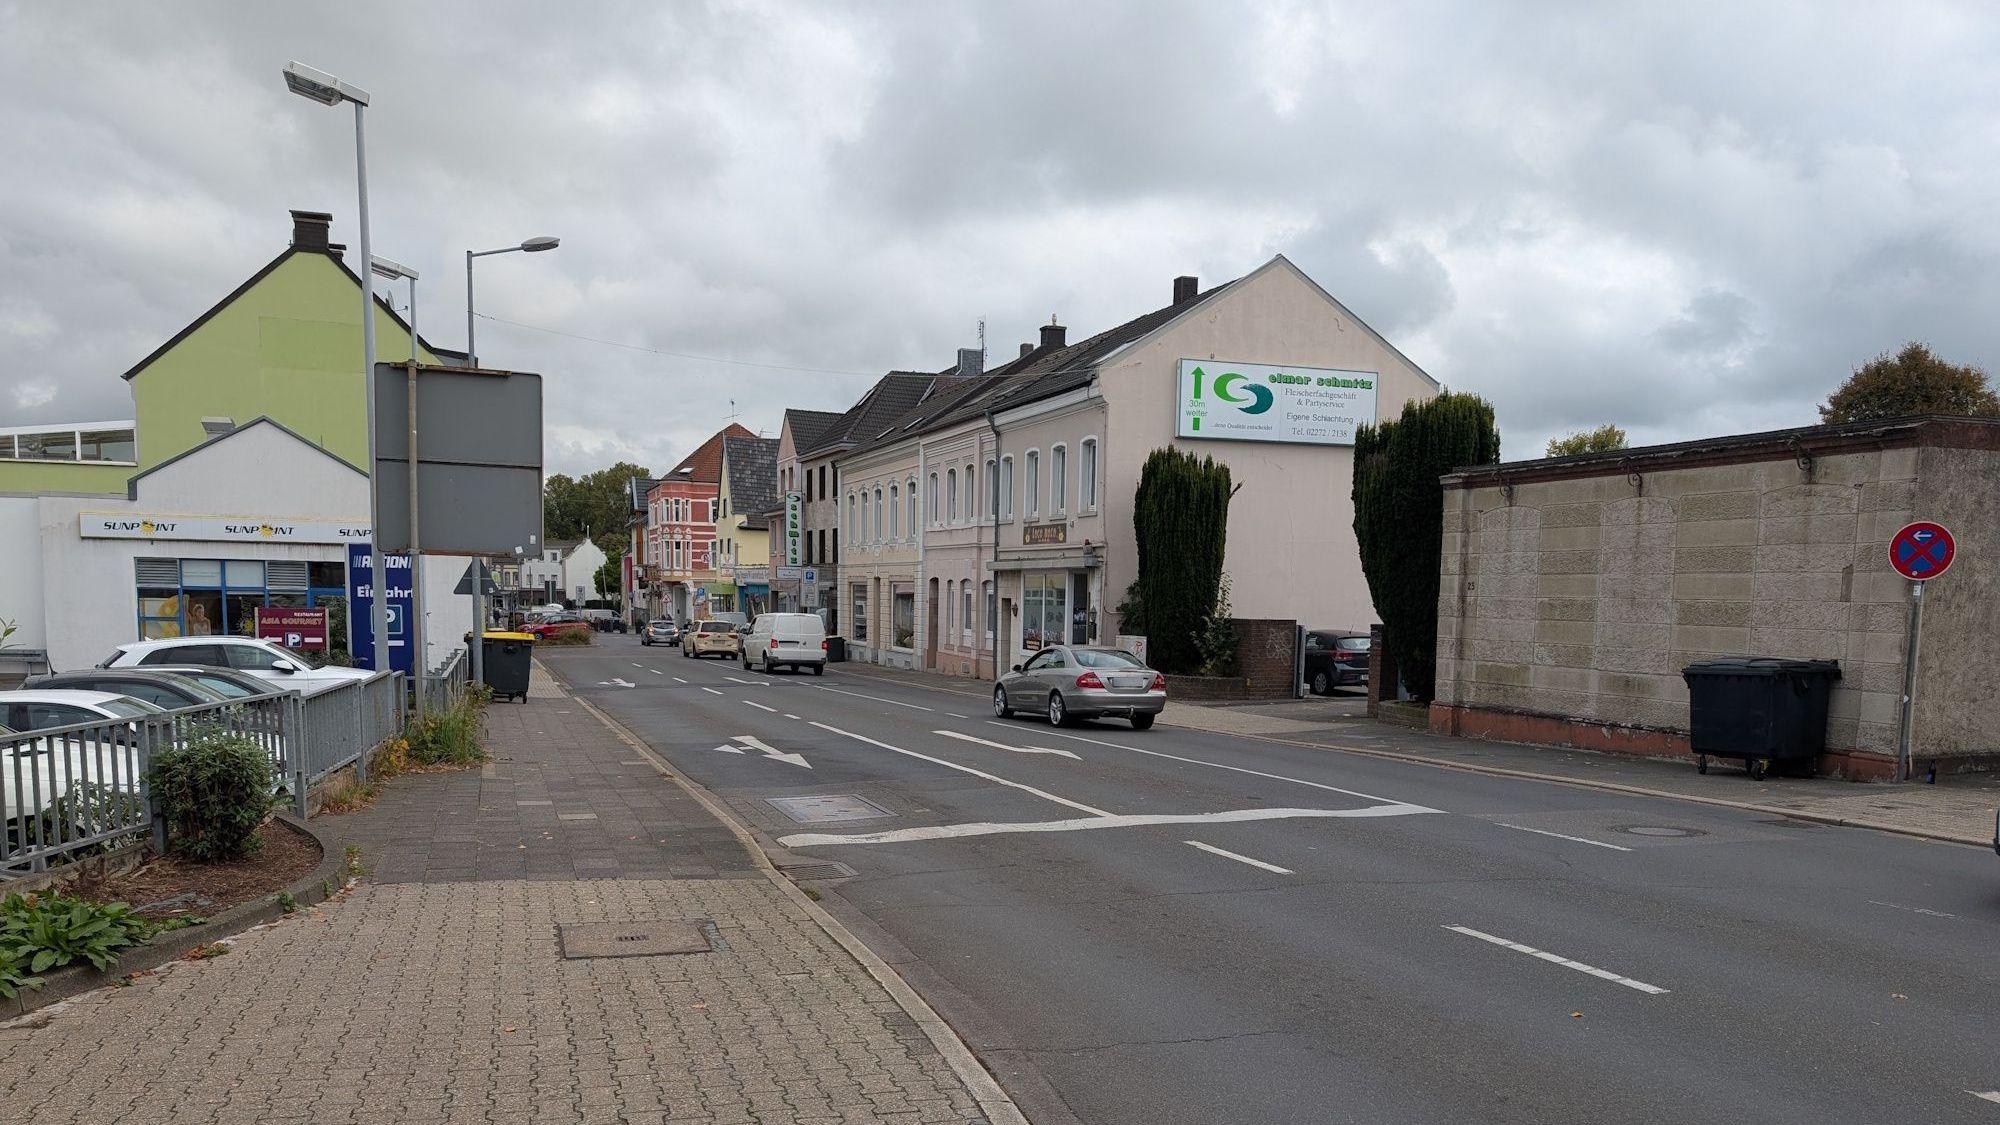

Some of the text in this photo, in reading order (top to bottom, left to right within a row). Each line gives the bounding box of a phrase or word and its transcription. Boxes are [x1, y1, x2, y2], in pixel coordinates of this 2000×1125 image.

[1269, 373, 1373, 389] elmar schmitz
[1285, 388, 1357, 400] Fleischerfachgeschäft
[1189, 399, 1206, 408] 30m
[1305, 399, 1345, 409] Partyservice
[1185, 408, 1208, 417] weiter
[1286, 412, 1354, 425] Eigene Schlachtung
[1292, 428, 1305, 436] Tel.
[261, 617, 323, 625] ASIA GOURMET
